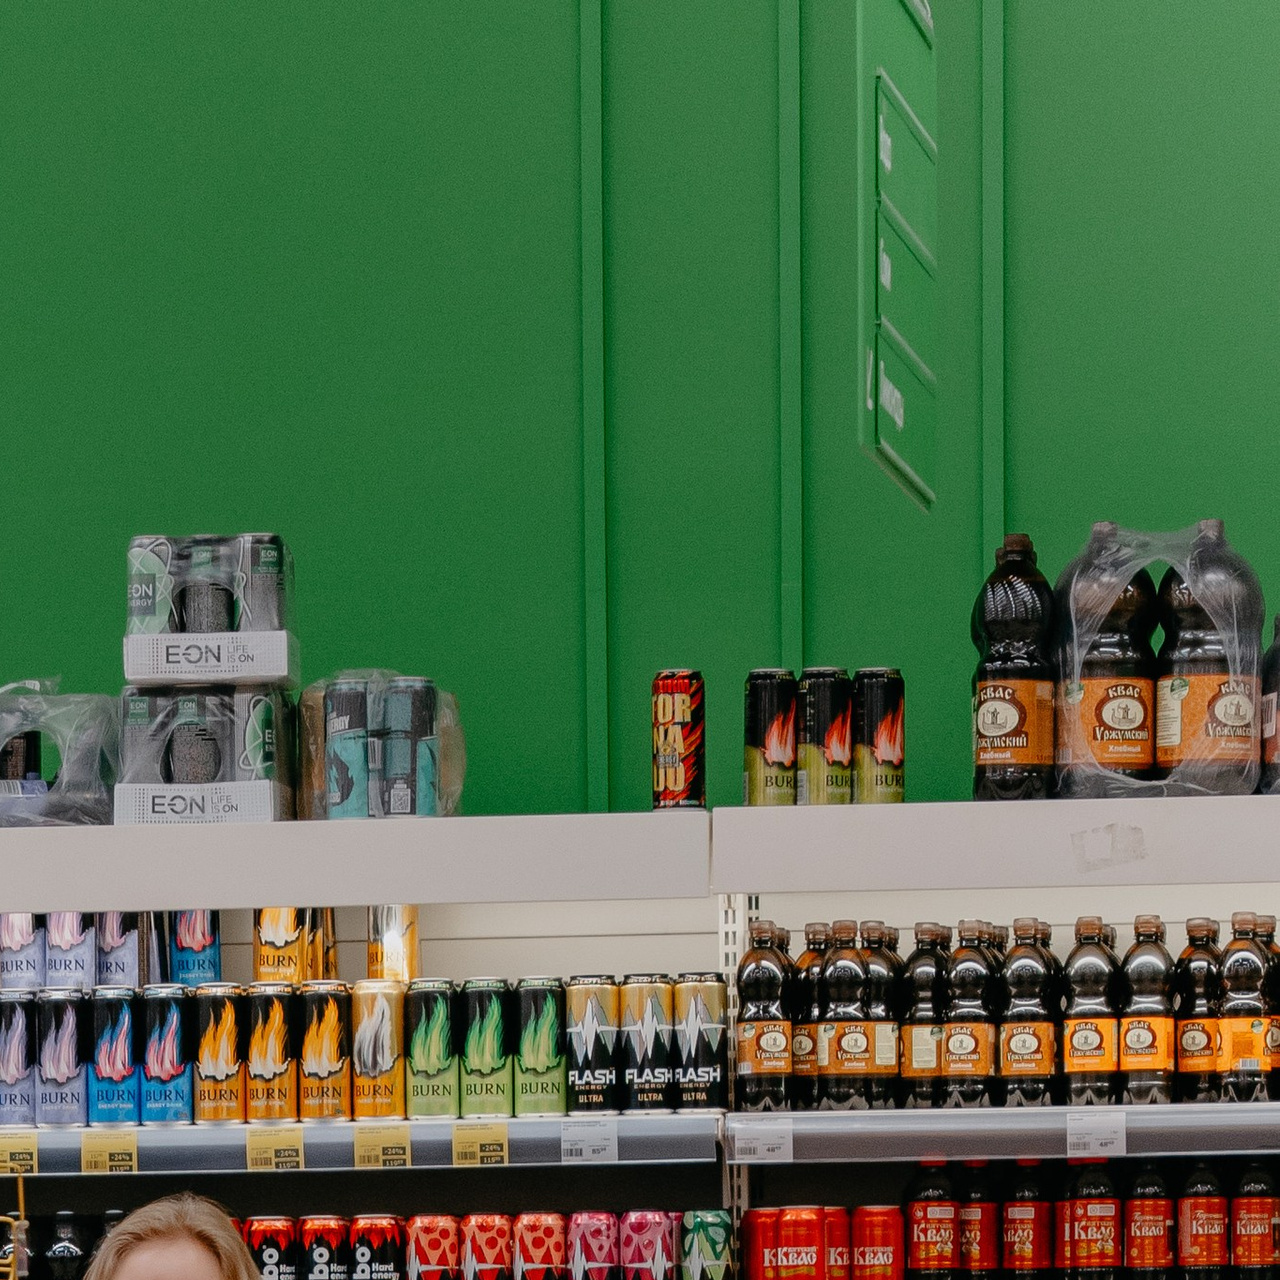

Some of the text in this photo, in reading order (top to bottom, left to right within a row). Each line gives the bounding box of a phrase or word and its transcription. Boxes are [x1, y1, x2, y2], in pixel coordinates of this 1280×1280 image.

[166, 643, 221, 664] EON
[227, 645, 248, 654] LIFE
[227, 654, 254, 663] IS ON
[152, 795, 205, 815] EON
[211, 795, 231, 804] LIFE
[211, 803, 238, 814] IS ON
[1, 959, 36, 971] BURN
[48, 958, 85, 971] BURN
[177, 959, 216, 971] BURN
[259, 954, 298, 967] BURN
[569, 1068, 616, 1085] FLASH
[625, 1068, 672, 1084] FLASH
[250, 1087, 287, 1100] BURN
[304, 1086, 342, 1099] BURN
[355, 1083, 394, 1097] BURN
[412, 1084, 452, 1097] BURN
[466, 1083, 505, 1096] BURN
[521, 1081, 561, 1095] BURN
[41, 1092, 80, 1104] BURN
[97, 1089, 136, 1101] BURN
[146, 1089, 184, 1101] BURN
[200, 1088, 239, 1101] BURN
[579, 1094, 604, 1103] ULTRA
[638, 1093, 663, 1102] ULTRA
[683, 1092, 707, 1100] ULTRA
[372, 1262, 394, 1271] Hard
[372, 1272, 400, 1280] energy
